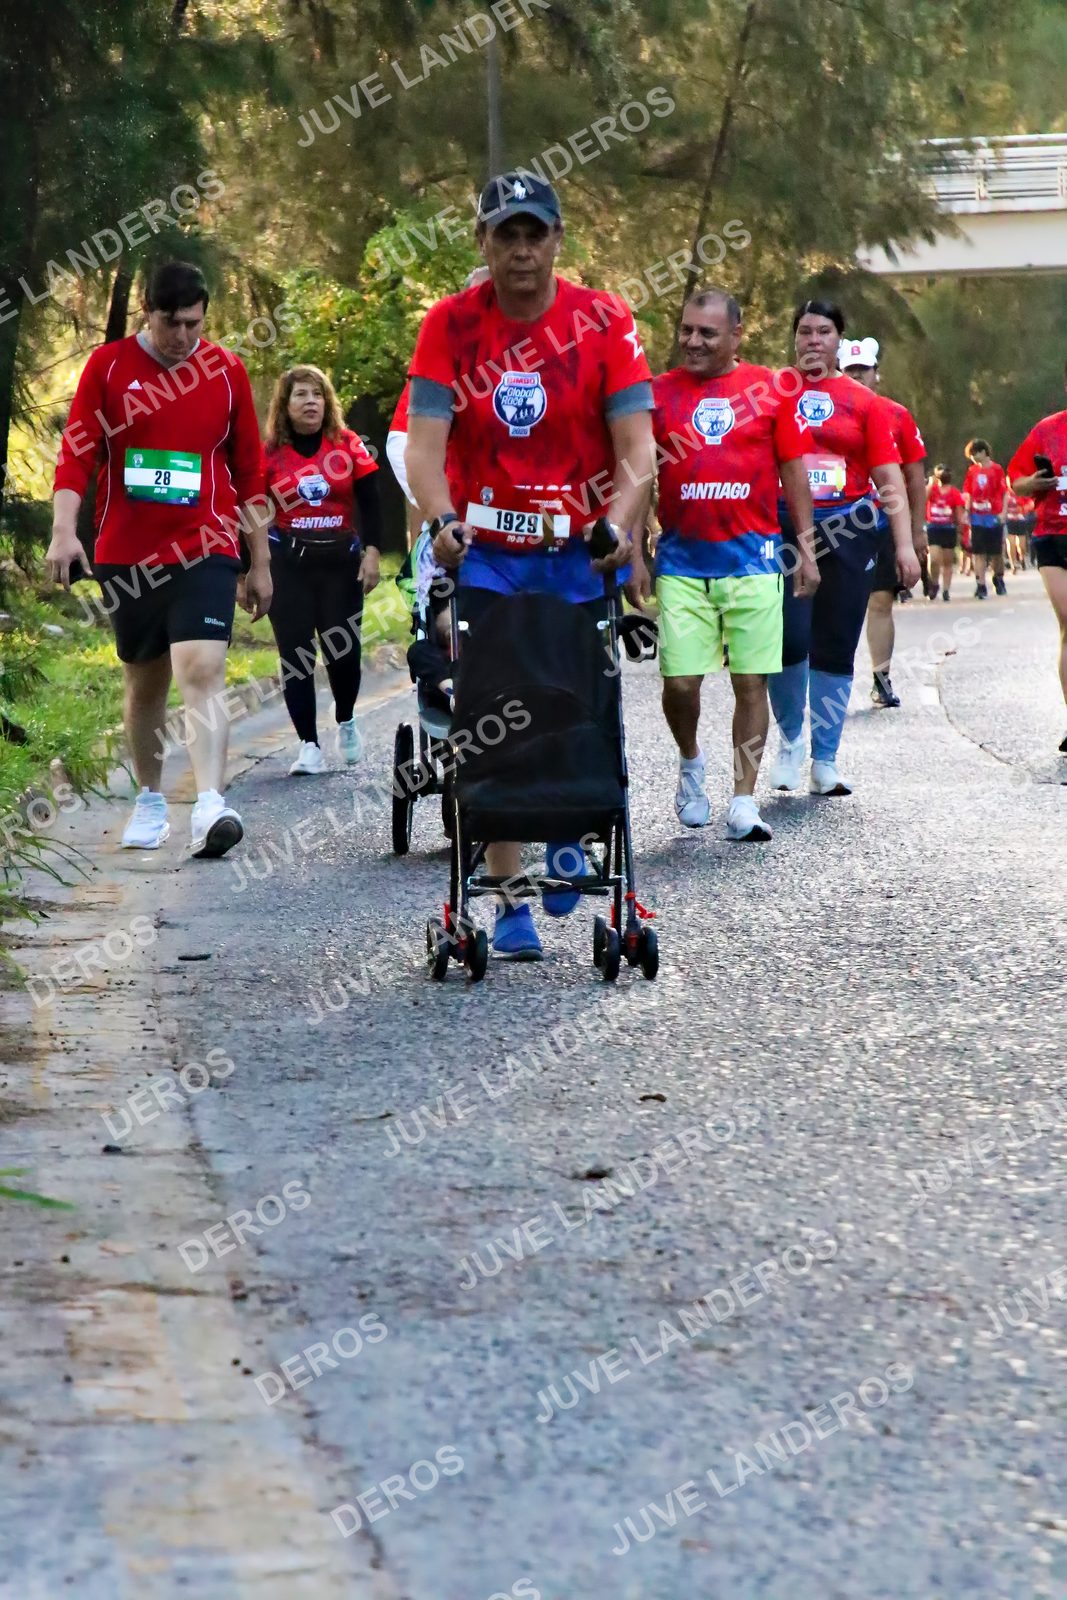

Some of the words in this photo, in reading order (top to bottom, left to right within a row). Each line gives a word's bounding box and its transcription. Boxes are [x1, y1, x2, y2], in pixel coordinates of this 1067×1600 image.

[851, 345, 861, 356] B
[507, 387, 535, 398] Global
[501, 395, 524, 406] Race
[154, 470, 171, 486] 28
[681, 482, 751, 500] SANTIAGO
[291, 515, 343, 529] SANTIAGO
[496, 510, 539, 534] 1929
